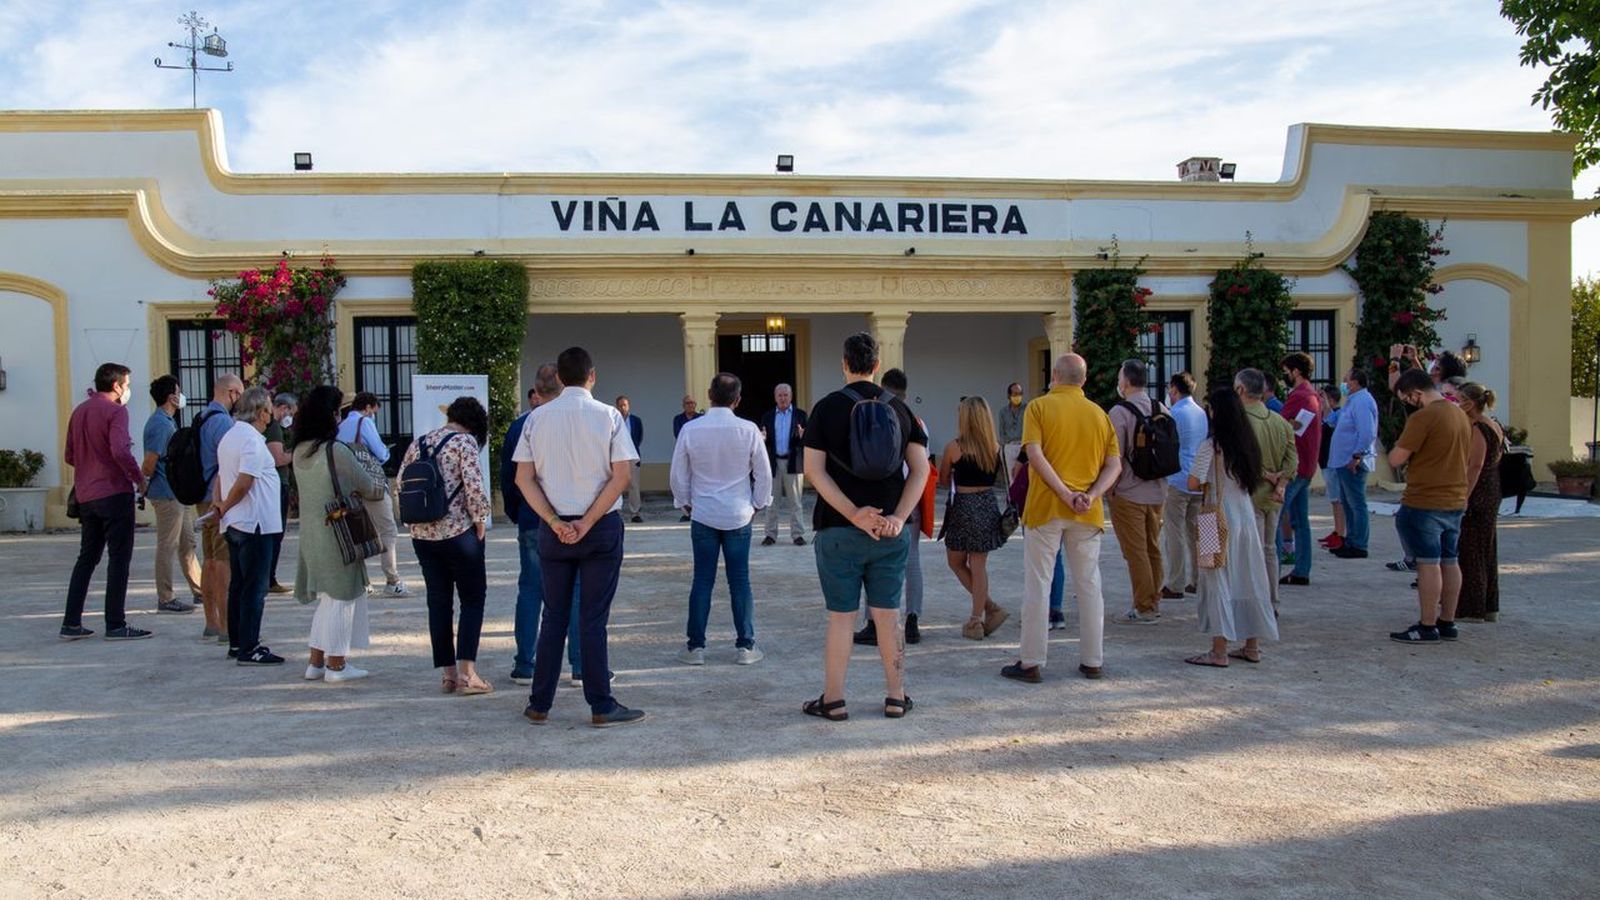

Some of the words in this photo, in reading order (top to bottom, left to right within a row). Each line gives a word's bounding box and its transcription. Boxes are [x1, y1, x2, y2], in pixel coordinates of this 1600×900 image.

[550, 196, 661, 232] VIÑA
[685, 201, 746, 232] LA
[770, 202, 1028, 235] CANARIERA
